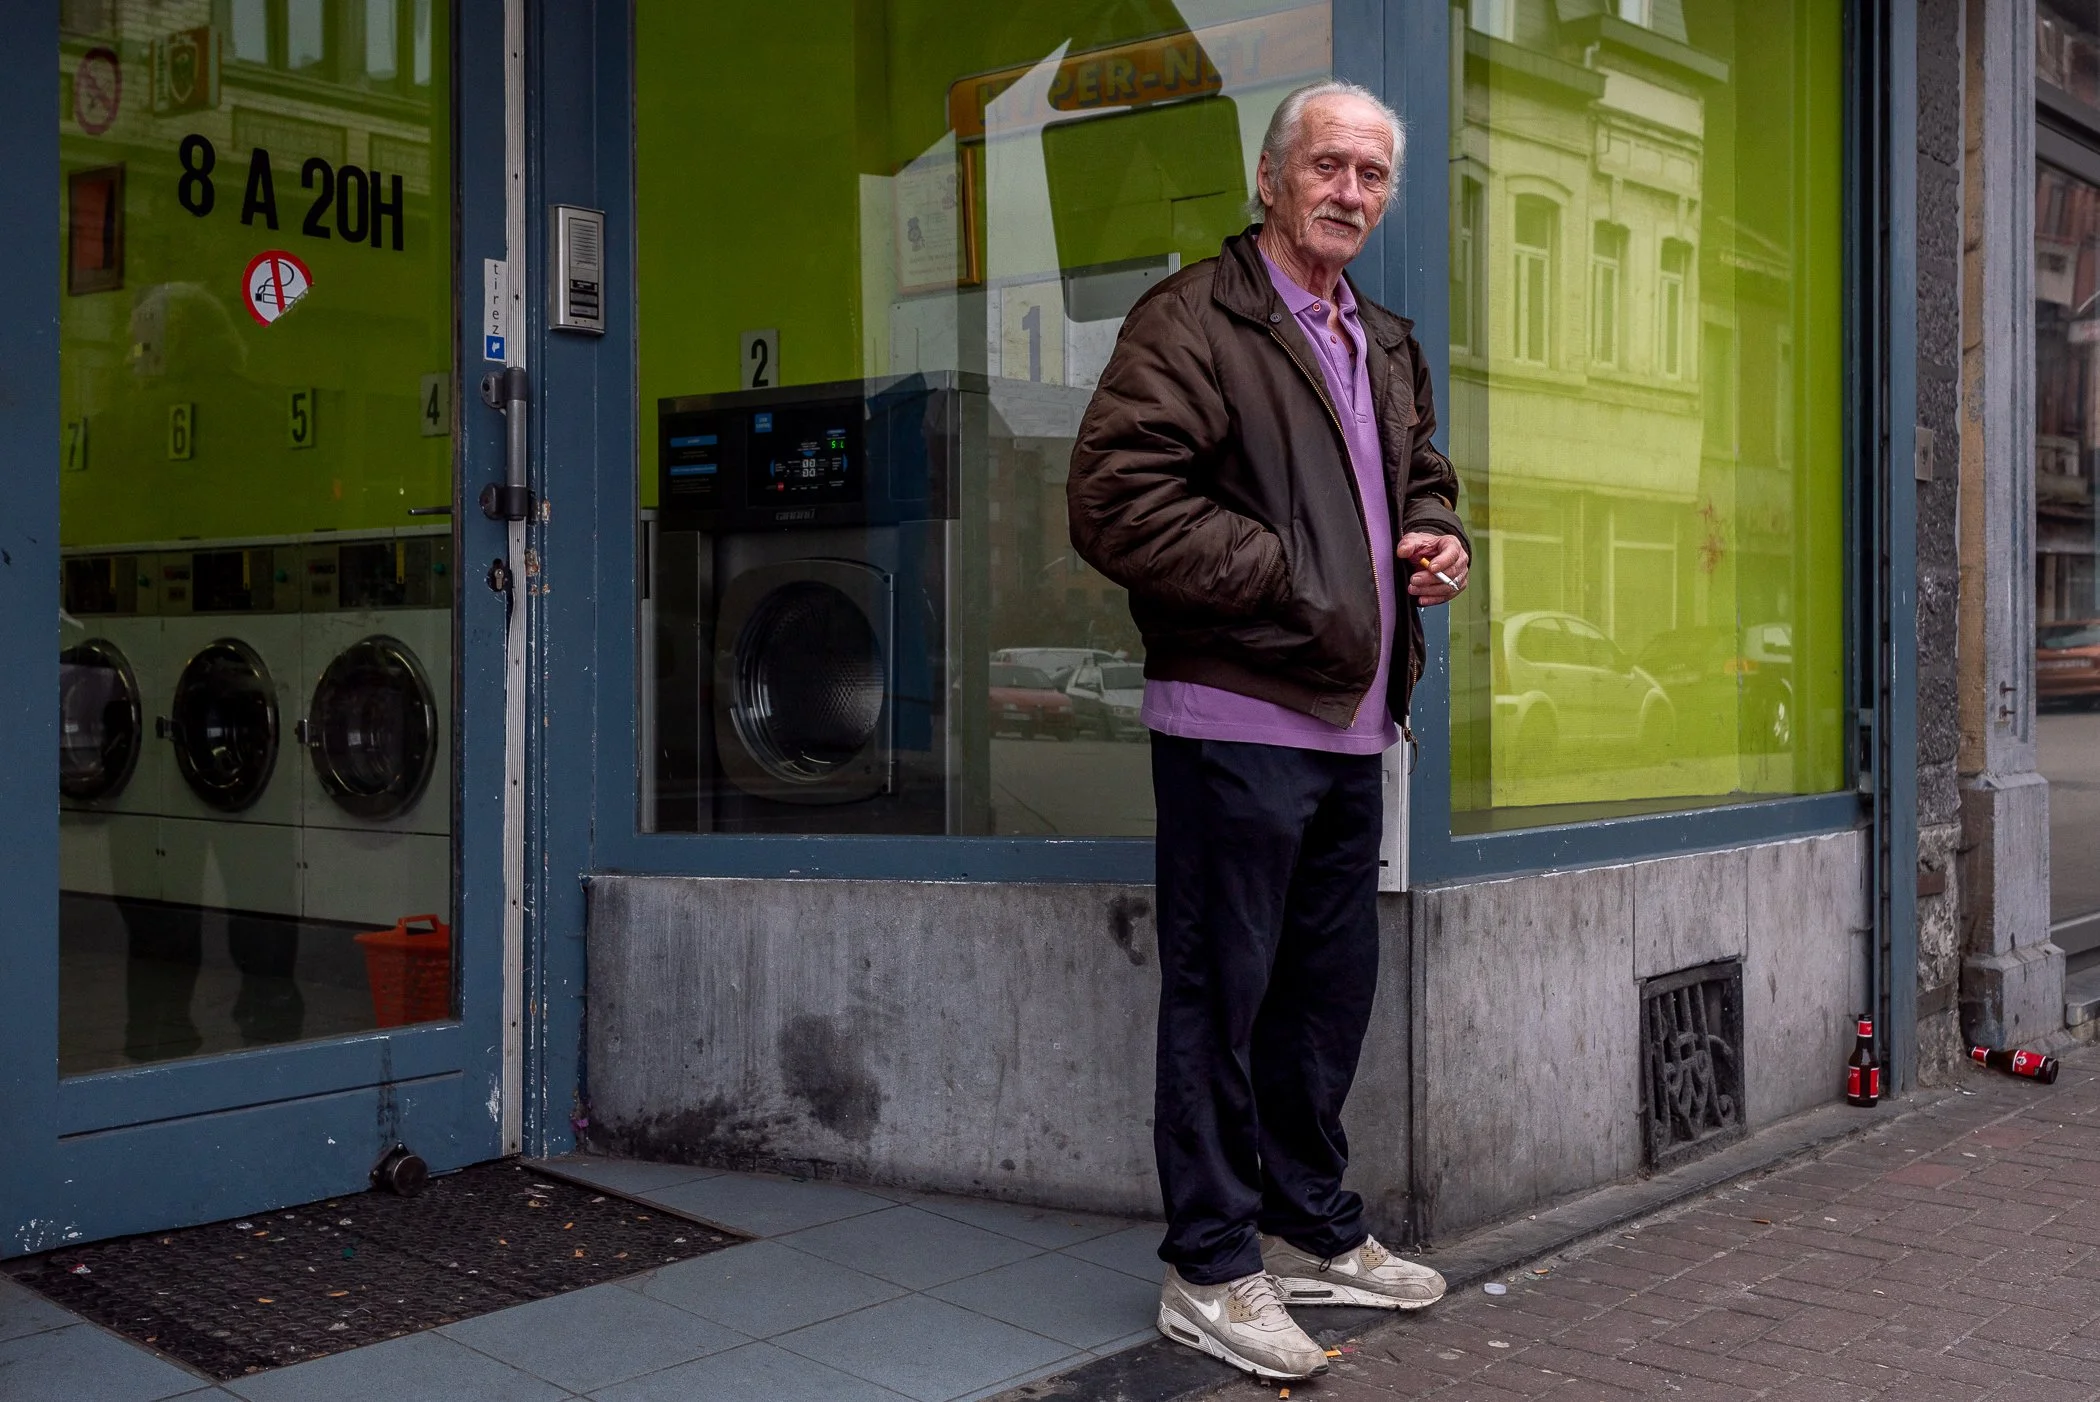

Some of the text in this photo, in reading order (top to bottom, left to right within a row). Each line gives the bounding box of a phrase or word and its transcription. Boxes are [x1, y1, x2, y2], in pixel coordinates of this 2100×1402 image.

[178, 134, 404, 251] 8 A 20H
[492, 263, 500, 334] tirez
[751, 339, 769, 388] 2
[1022, 304, 1042, 383] 1
[291, 392, 307, 443] 5
[426, 382, 441, 425] 4
[66, 421, 78, 467] 7
[172, 407, 186, 455] 6
